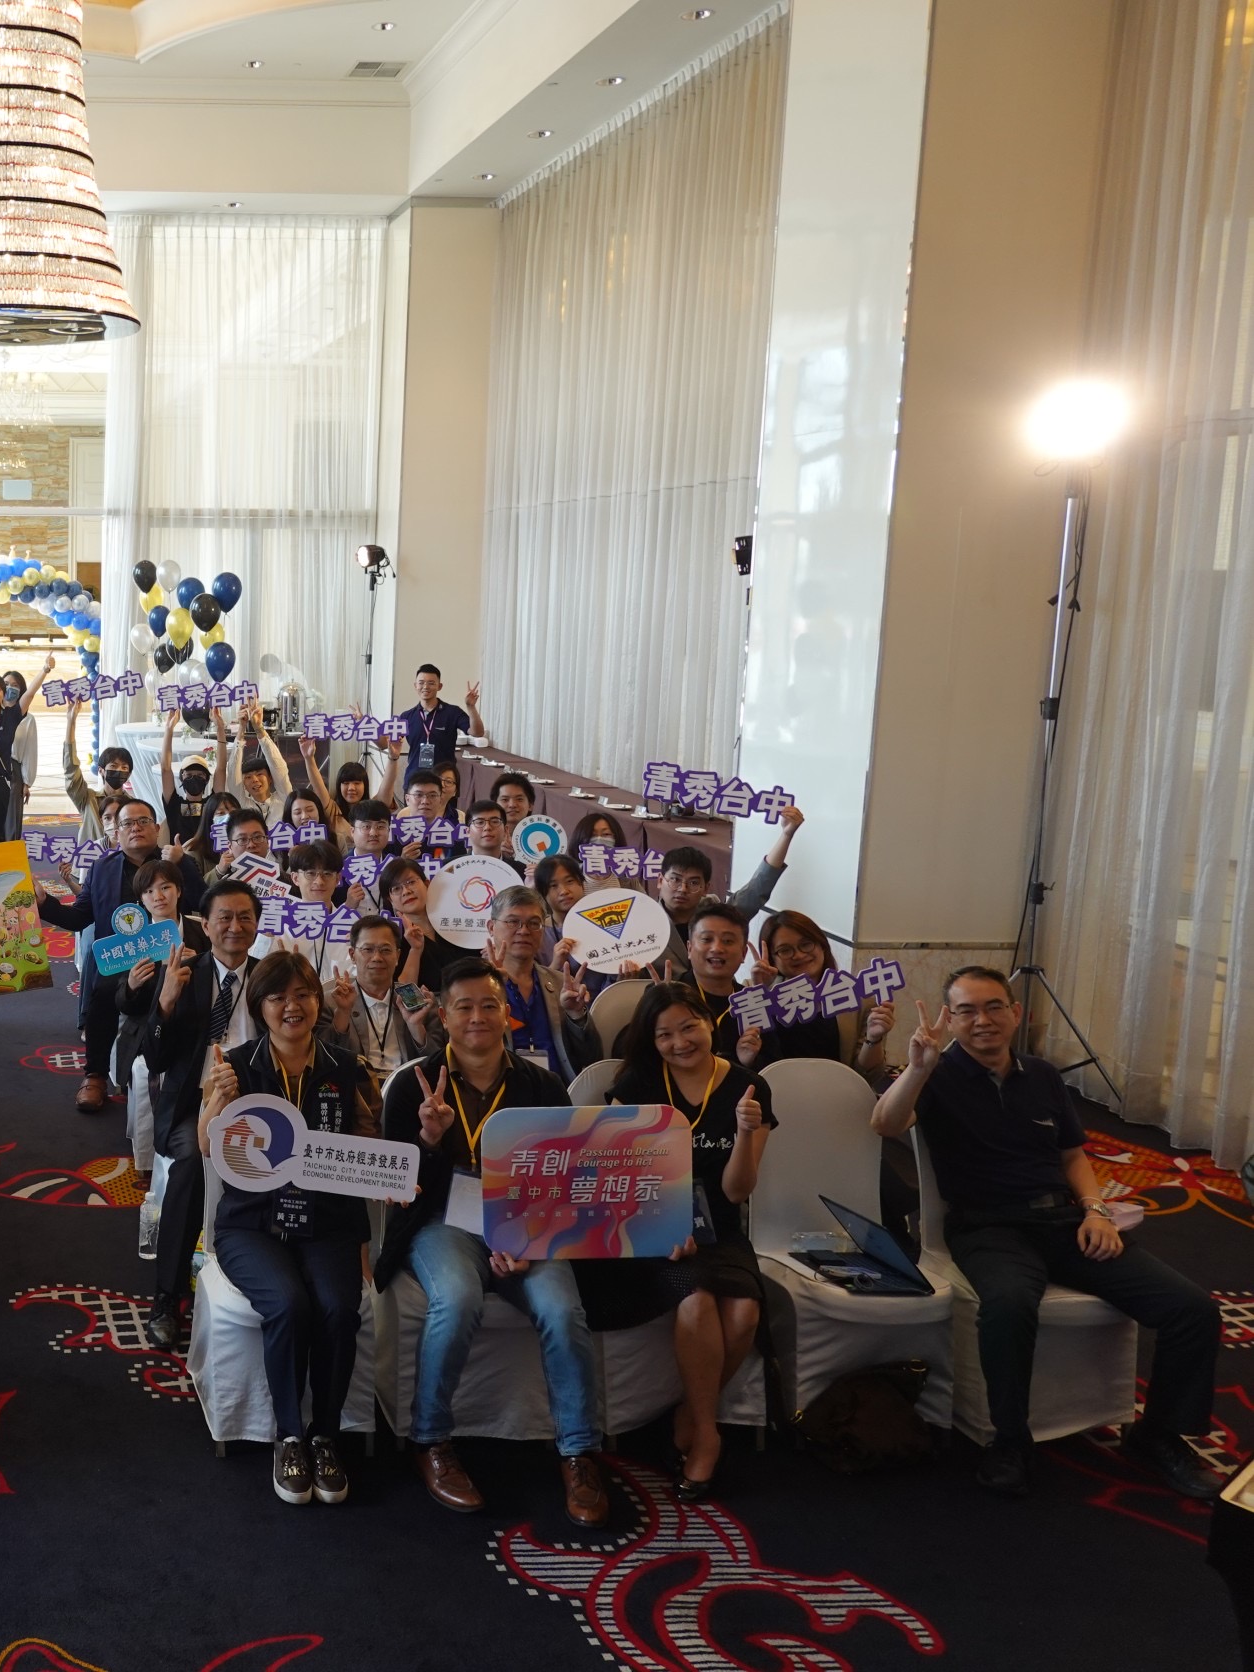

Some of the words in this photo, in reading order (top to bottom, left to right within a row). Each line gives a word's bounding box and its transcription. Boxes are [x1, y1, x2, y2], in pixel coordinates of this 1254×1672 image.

[44, 673, 144, 707] 青秀台中
[159, 681, 258, 712] 青秀台中
[305, 714, 407, 741] 青秀台中
[644, 763, 794, 823] 青秀台中
[213, 822, 326, 850] 青台中
[388, 816, 472, 847] 秀台
[24, 832, 118, 867] 青秀台
[582, 845, 664, 877] 青秀台
[258, 899, 402, 941] 青秀台
[101, 929, 173, 964] 中國醫藥大學
[587, 934, 657, 959] 國立中央大學
[734, 962, 904, 1031] 青秀台中
[303, 1143, 410, 1171] 臺中市政府經濟發展局
[510, 1149, 571, 1177] 青創
[577, 1159, 619, 1168] Courage
[623, 1158, 633, 1166] to
[635, 1158, 653, 1166] Act
[579, 1148, 619, 1158] Passion
[622, 1148, 633, 1156] to
[635, 1147, 669, 1156] Dream
[302, 1170, 335, 1180] ECONOMIC
[335, 1174, 380, 1187] DEVELOPMENT
[381, 1181, 406, 1190] BUREAU
[303, 1161, 337, 1172] TAICHUNG
[341, 1167, 357, 1175] CITY
[360, 1169, 406, 1181] GOVERNMENT
[506, 1185, 563, 1200] 臺中市
[570, 1175, 663, 1204] 夢想家
